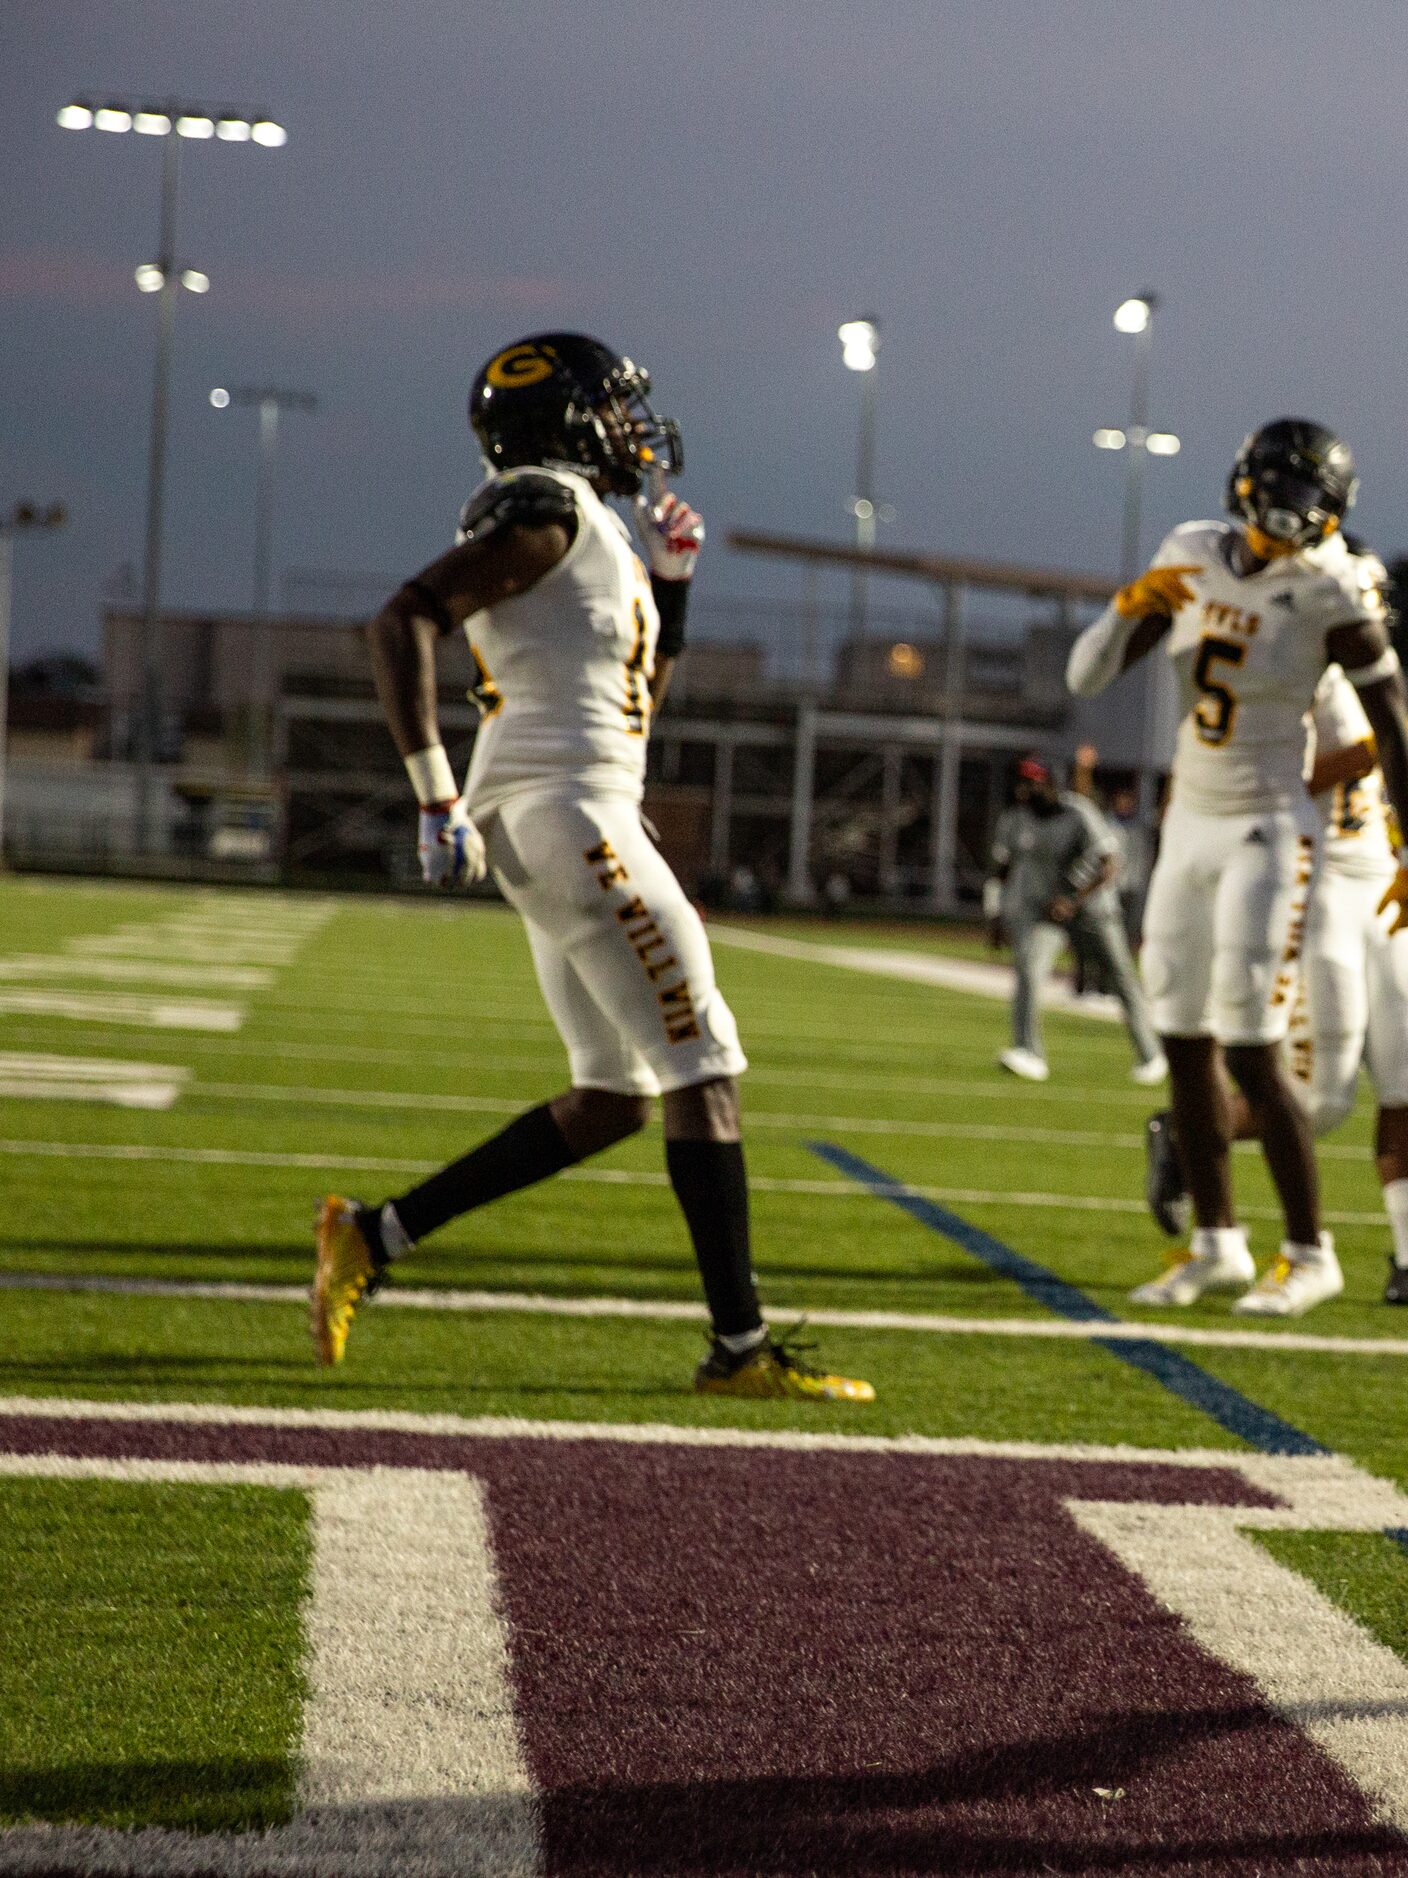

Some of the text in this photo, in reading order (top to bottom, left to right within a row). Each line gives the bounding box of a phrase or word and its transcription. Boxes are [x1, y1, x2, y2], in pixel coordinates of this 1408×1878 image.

[485, 343, 557, 389] G
[1192, 632, 1249, 748] 5
[583, 839, 701, 1045] WE WILL WIN
